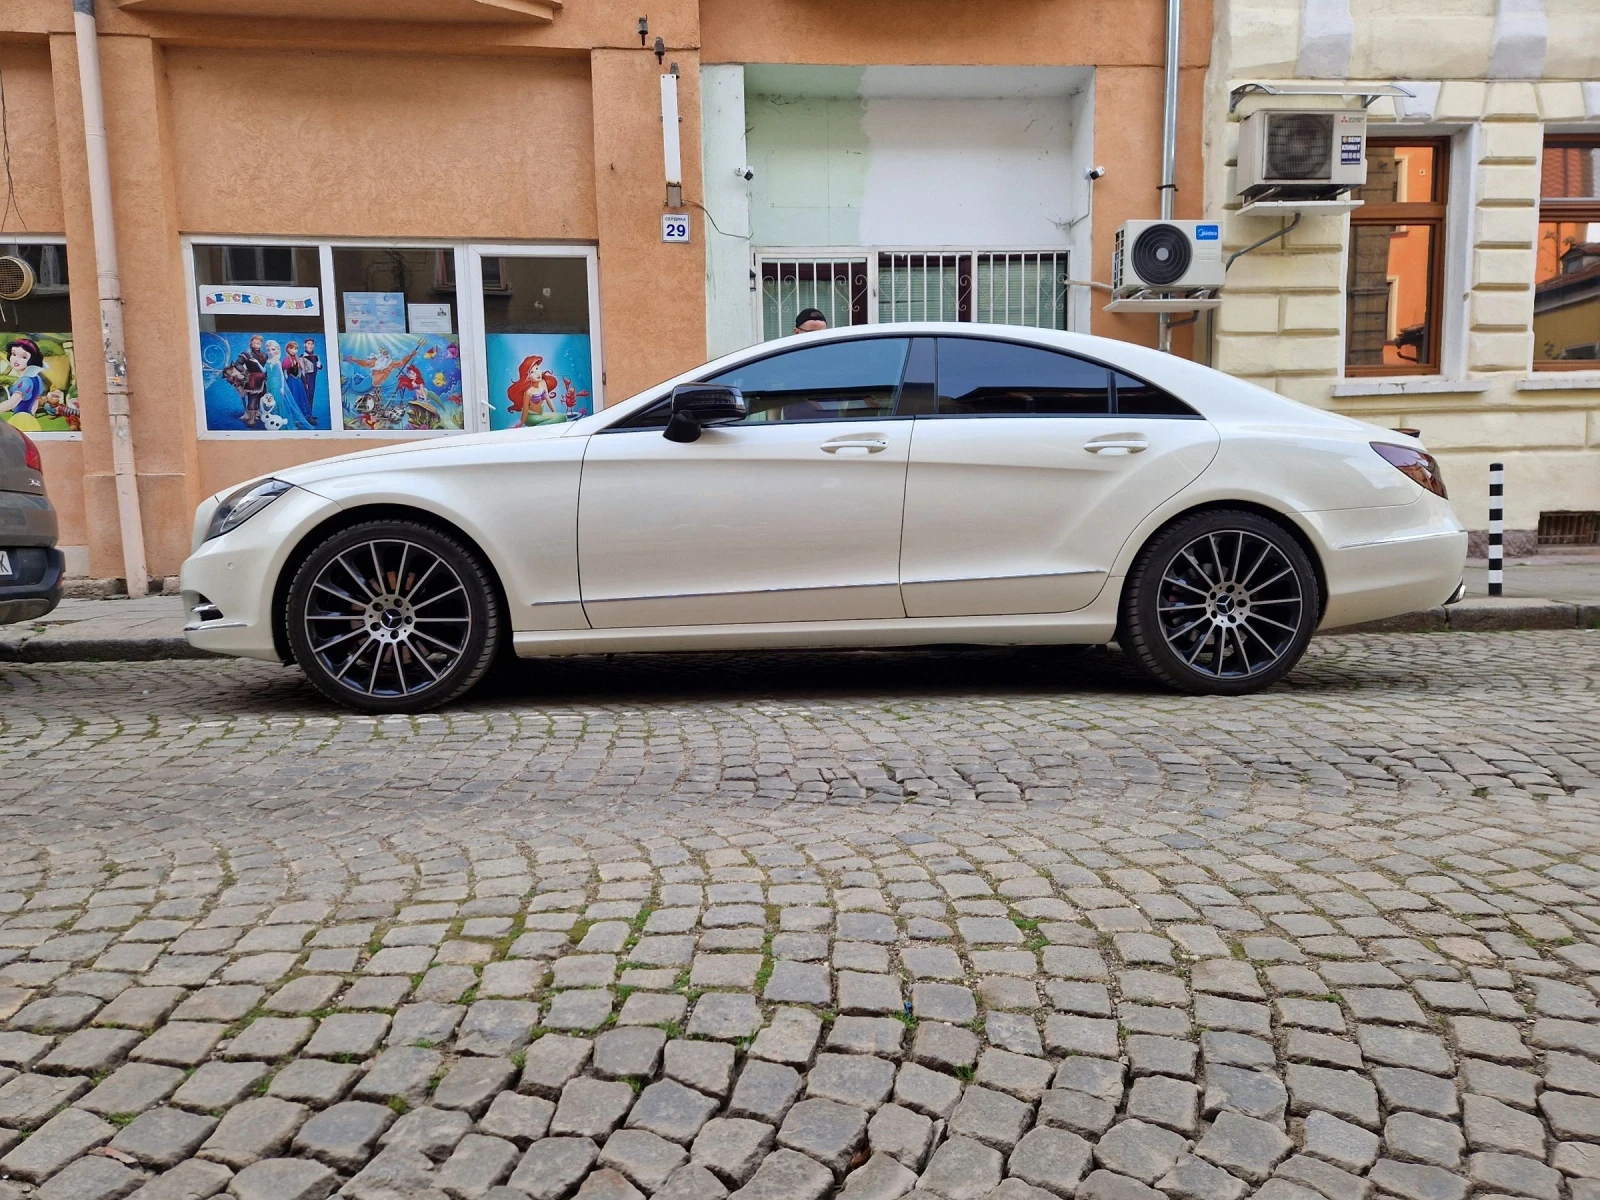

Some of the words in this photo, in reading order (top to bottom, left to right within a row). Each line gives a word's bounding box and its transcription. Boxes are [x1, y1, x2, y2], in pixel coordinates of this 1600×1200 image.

[666, 223, 686, 237] 29
[206, 292, 261, 307] ДЕТСКА
[265, 298, 314, 309] КУХНЯ
